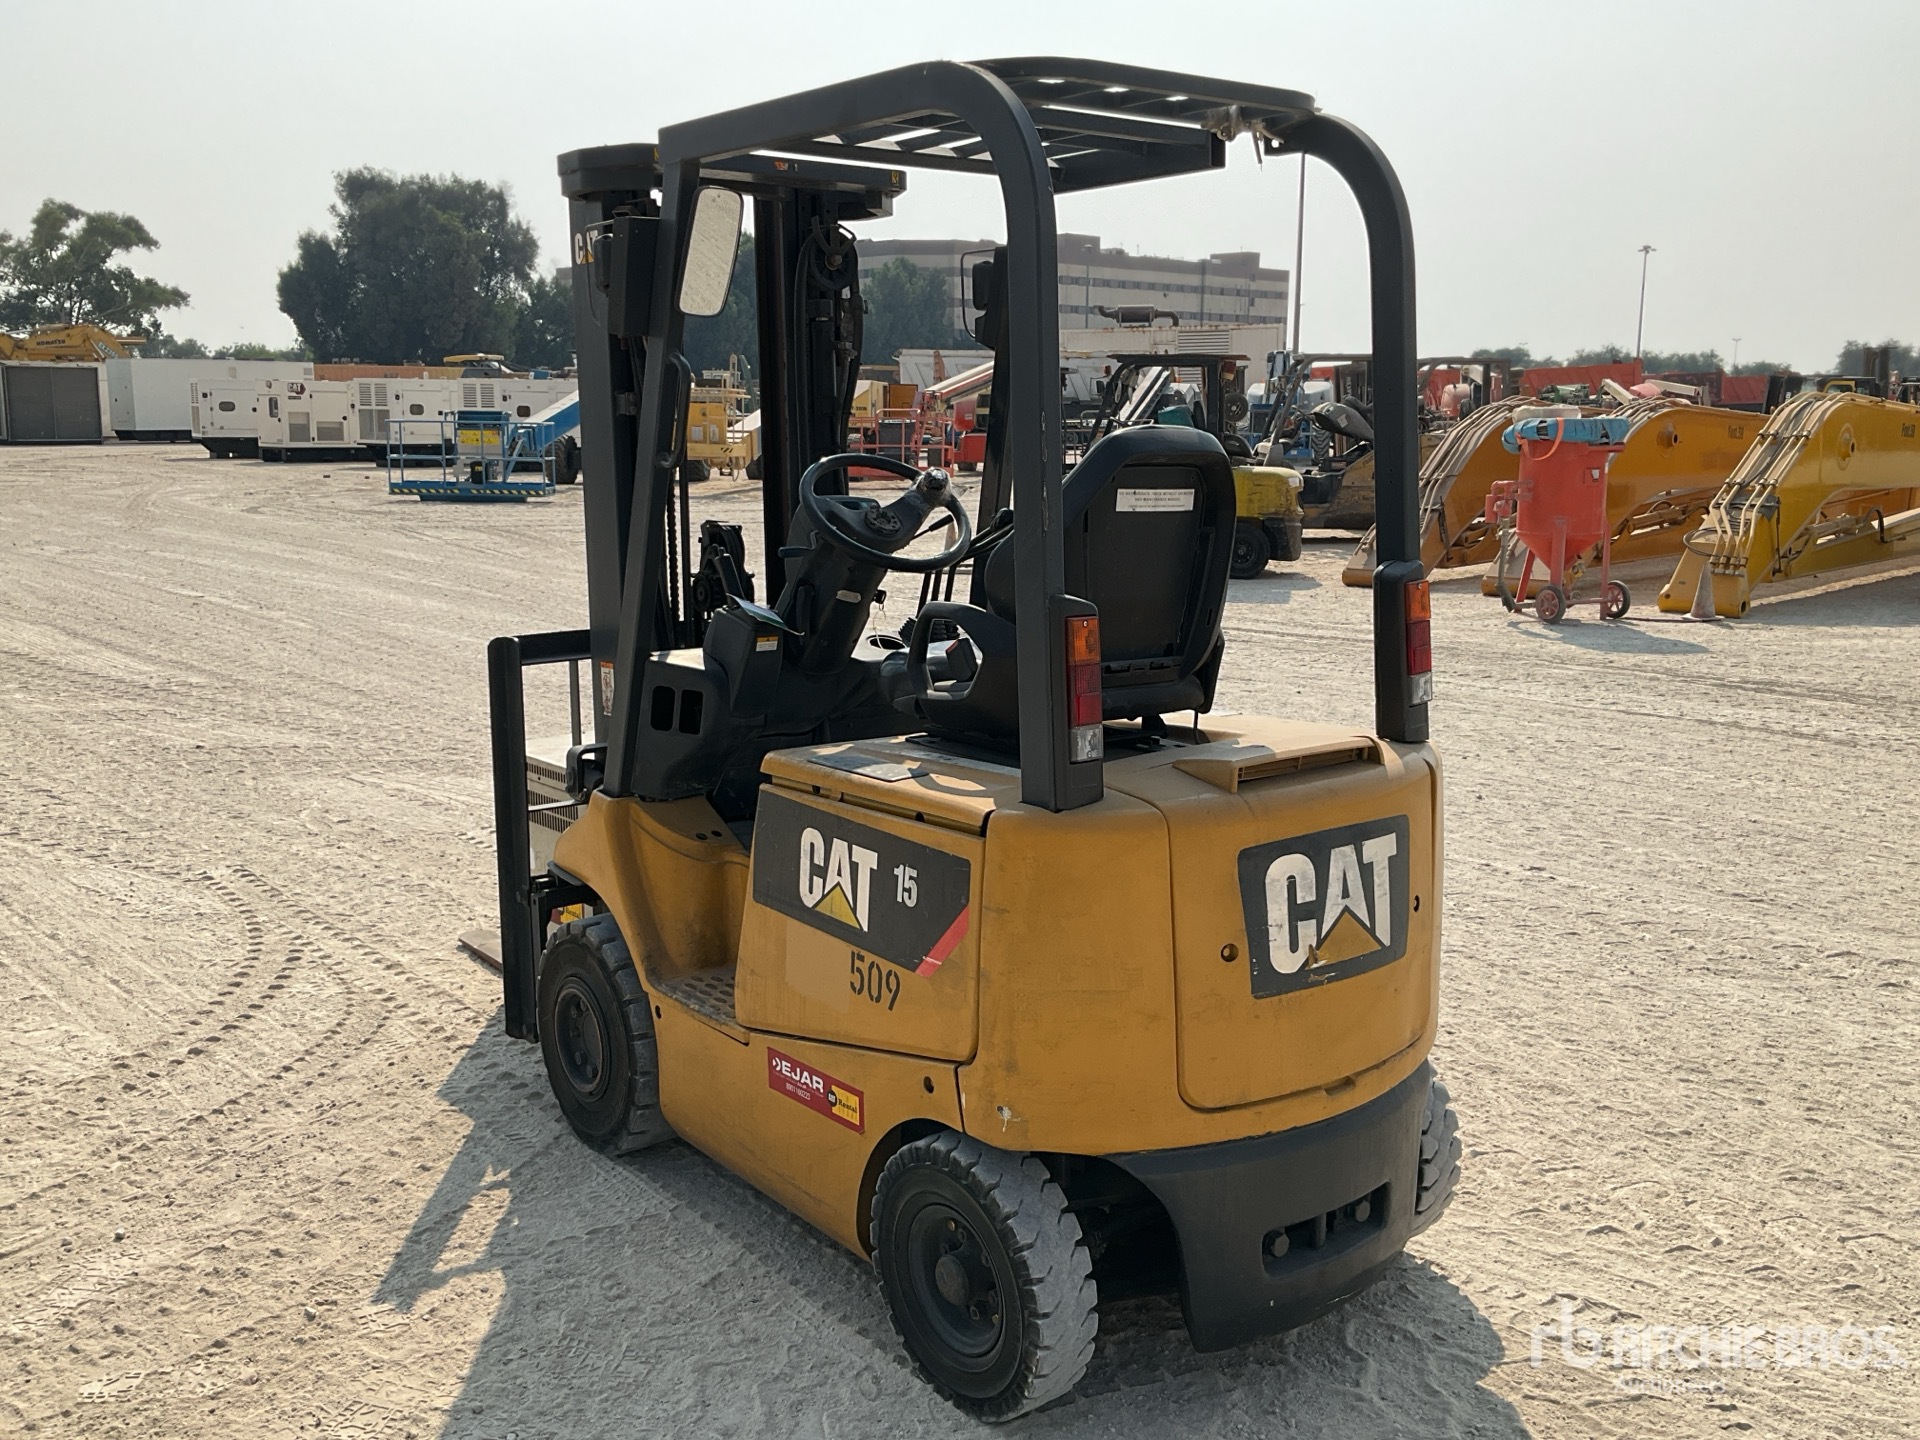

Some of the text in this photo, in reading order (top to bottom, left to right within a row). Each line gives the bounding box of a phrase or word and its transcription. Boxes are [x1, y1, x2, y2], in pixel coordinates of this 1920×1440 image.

[287, 382, 302, 393] CAT
[799, 827, 918, 932] CAT 15
[1265, 832, 1397, 974] CAT
[849, 950, 901, 1011] 509
[838, 1098, 857, 1114] Rental
